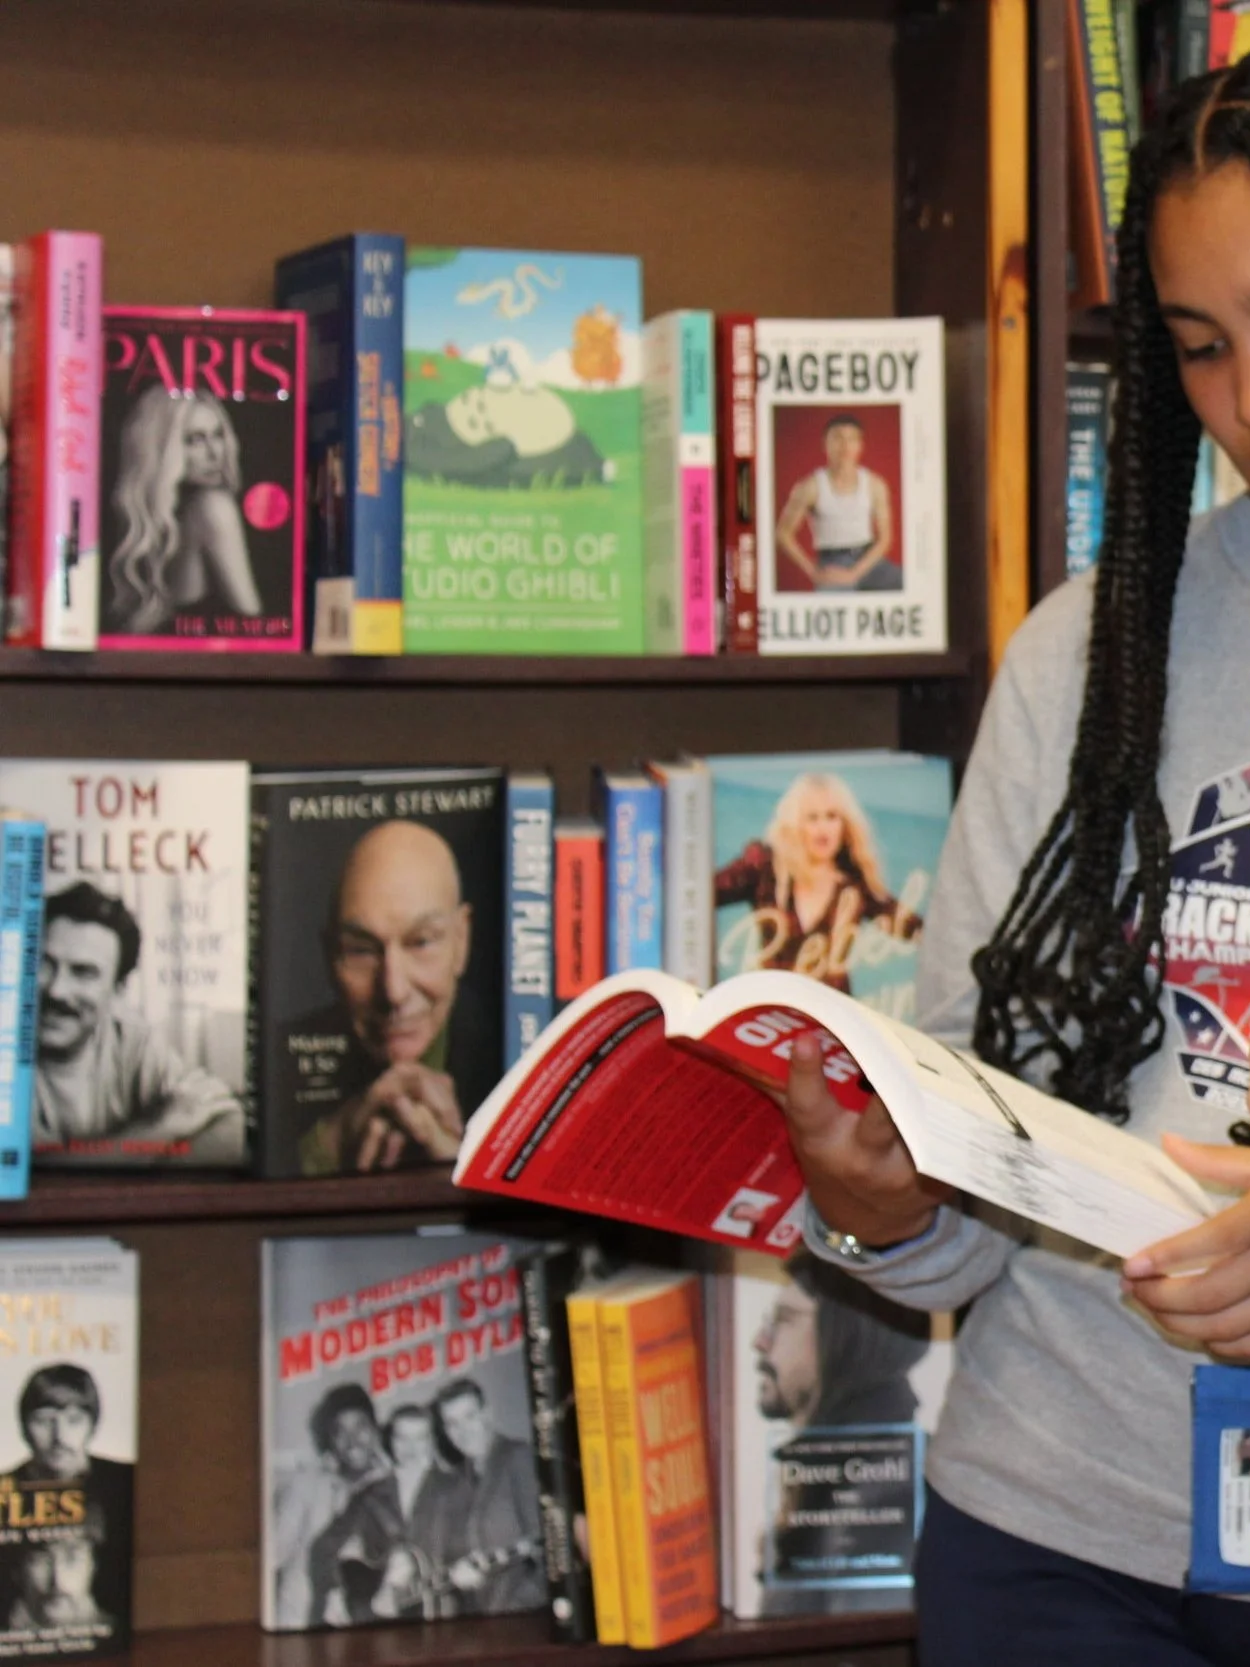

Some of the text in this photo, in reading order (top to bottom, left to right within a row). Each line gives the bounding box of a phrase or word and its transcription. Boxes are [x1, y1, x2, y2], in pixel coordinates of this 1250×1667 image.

[102, 331, 292, 399] PARIS
[757, 351, 919, 393] PAGEBOY
[1066, 429, 1096, 575] THE UNDE
[446, 531, 567, 565] WORLD
[574, 532, 618, 565] OF
[404, 566, 621, 601] UDIO GHIBLI
[760, 606, 923, 641] ELLIOT PAGE
[69, 776, 159, 818] TOM
[288, 786, 494, 822] PATRICK STEWART
[48, 830, 212, 873] ELLECK
[510, 806, 552, 999] FURRY PLANET
[718, 868, 930, 978] Rebel
[279, 1291, 443, 1380] MODERN
[369, 1312, 524, 1394] BOB DYLA
[782, 1457, 908, 1484] Dave Grohl
[0, 1489, 86, 1527] TLES
